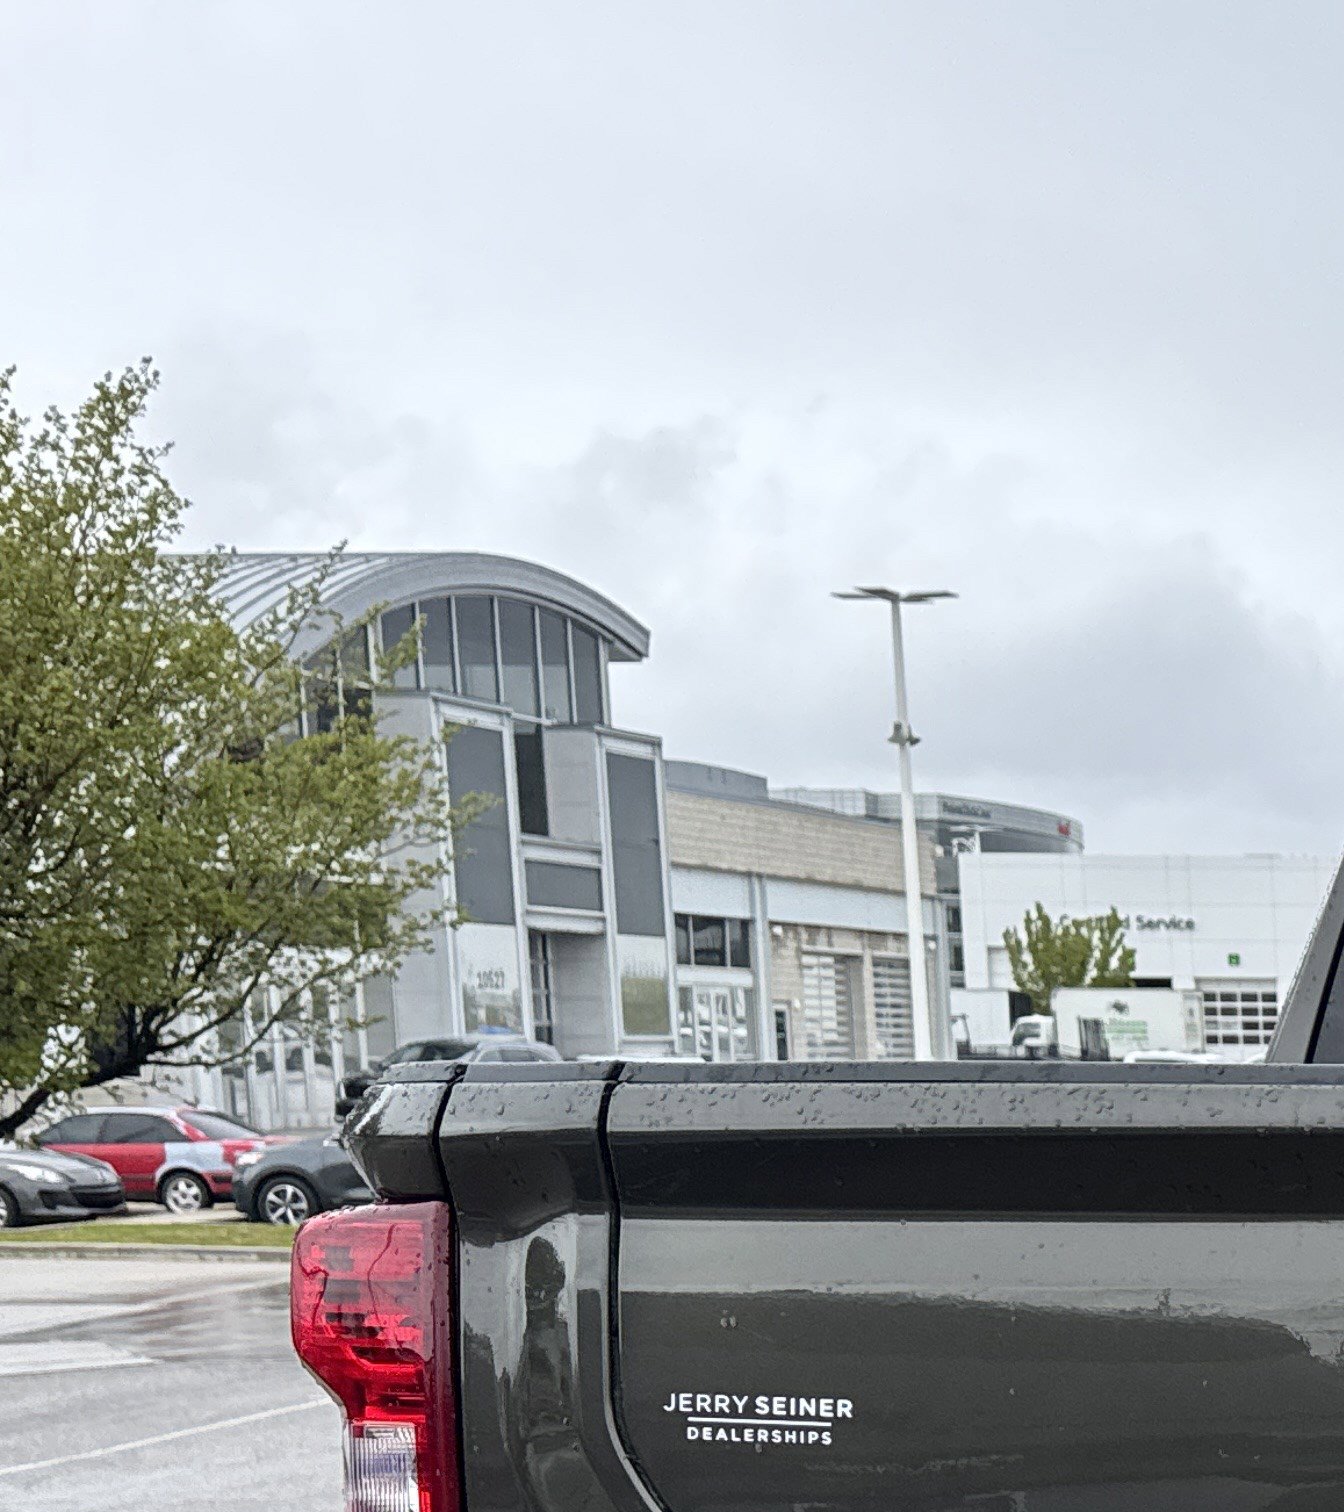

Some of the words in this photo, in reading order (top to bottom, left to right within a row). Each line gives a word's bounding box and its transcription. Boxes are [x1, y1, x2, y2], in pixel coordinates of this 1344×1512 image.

[663, 1393, 748, 1413] JERRY
[753, 1396, 853, 1418] SEINER
[687, 1426, 831, 1445] DEALERSHIPS
